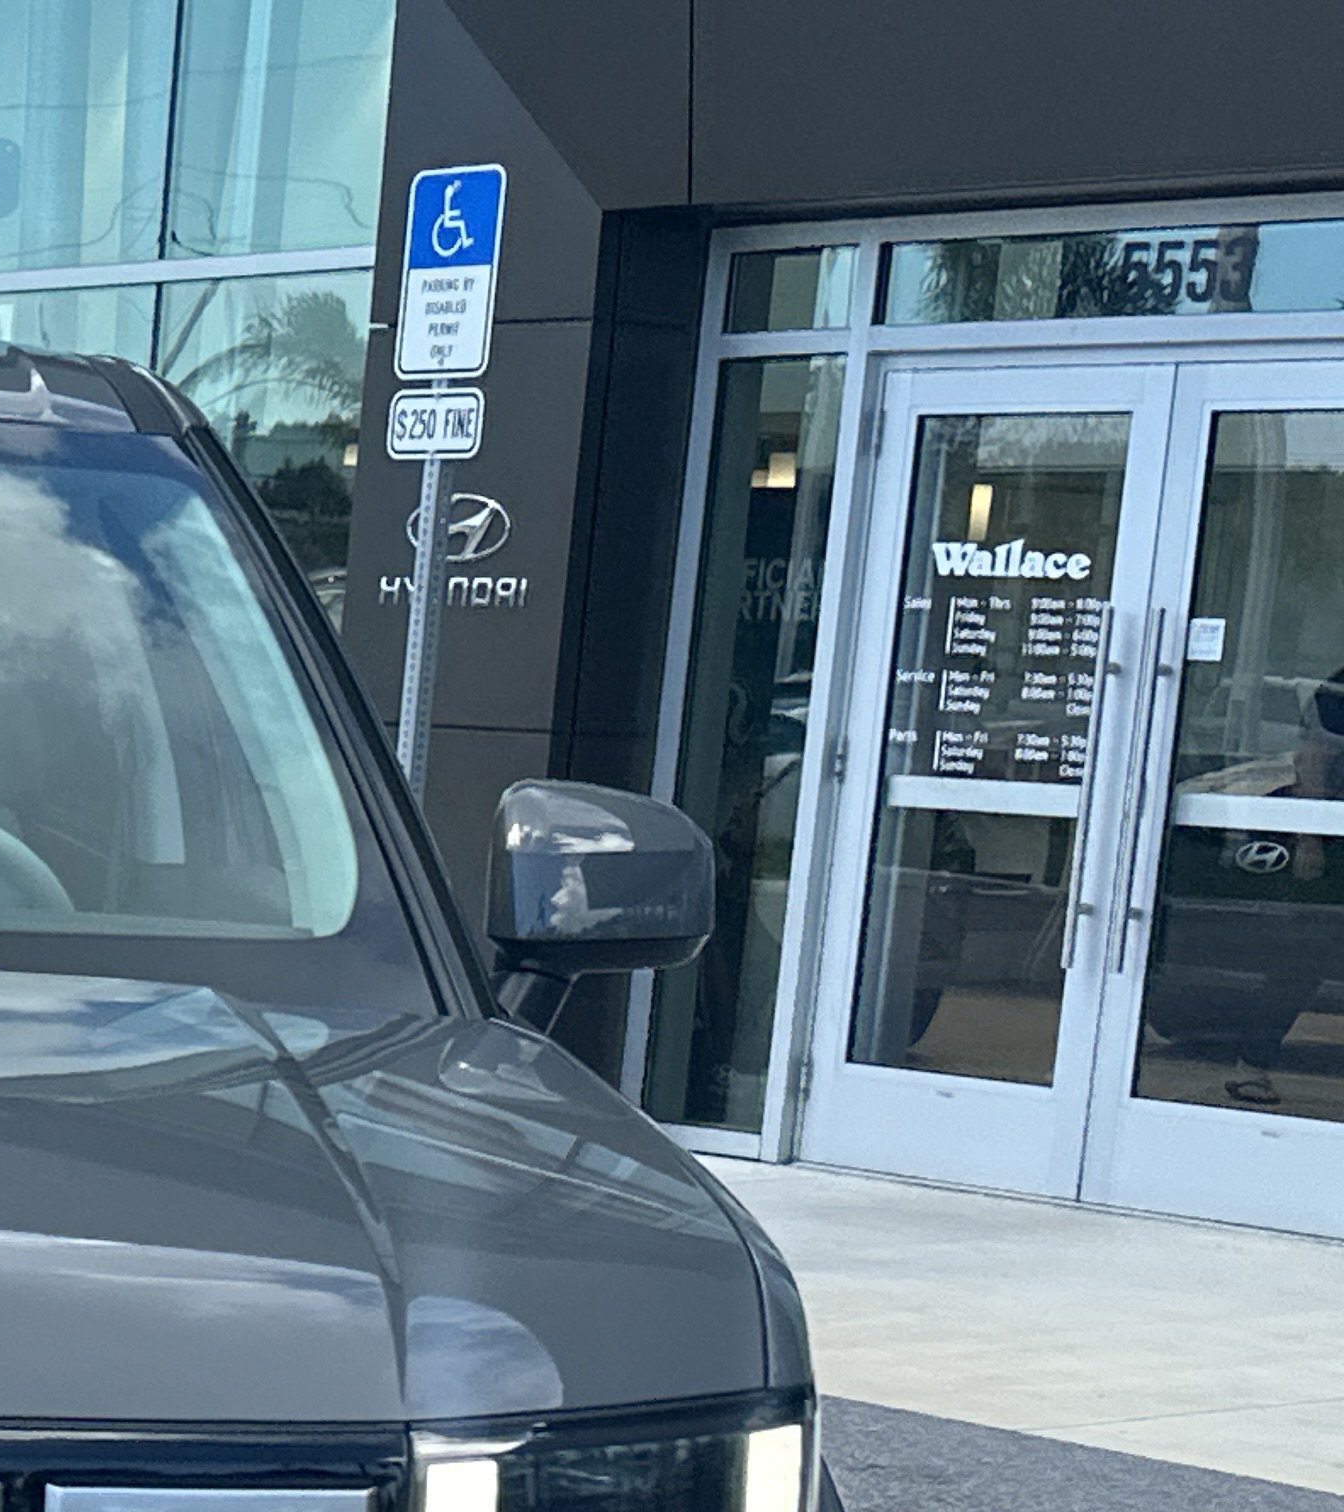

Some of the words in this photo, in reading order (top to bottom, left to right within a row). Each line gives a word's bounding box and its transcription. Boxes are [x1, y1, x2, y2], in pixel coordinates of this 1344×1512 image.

[425, 299, 467, 315] DISABLED
[428, 321, 460, 337] PERMIT
[395, 409, 437, 442] $250
[443, 407, 476, 440] FINE
[932, 538, 1092, 580] Wallace
[379, 575, 528, 607] HYNDAI
[896, 669, 936, 683] Service
[948, 670, 971, 682] Mon
[980, 671, 995, 683] Fri
[945, 700, 981, 715] Sunday
[889, 729, 917, 742] Parts
[942, 731, 964, 743] Mon
[973, 731, 988, 744] Fri
